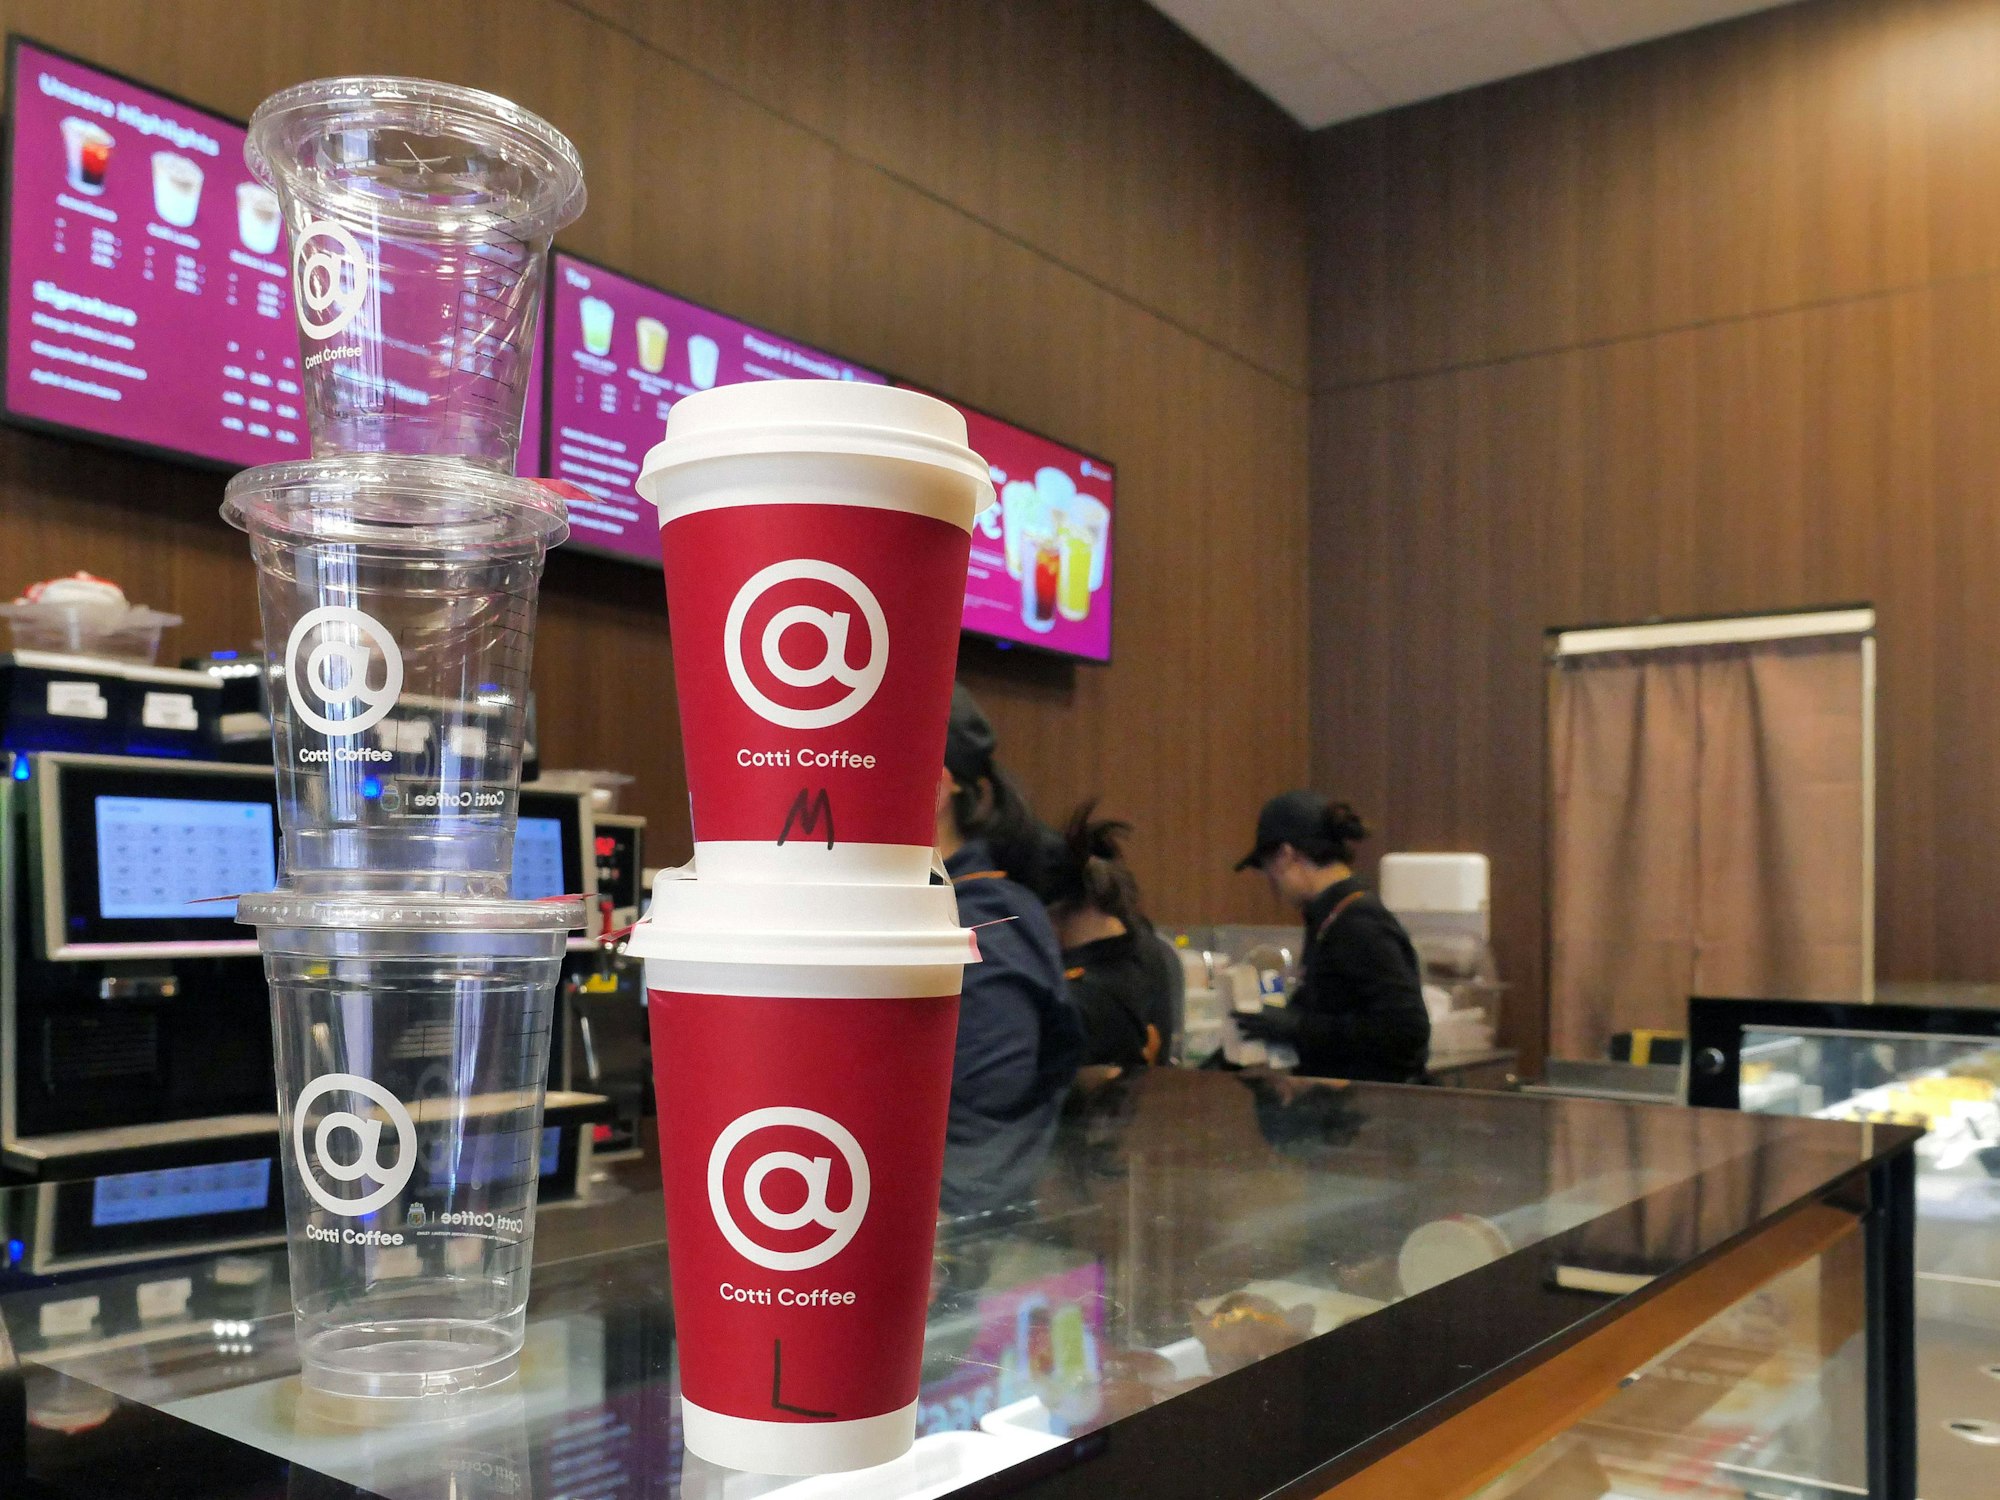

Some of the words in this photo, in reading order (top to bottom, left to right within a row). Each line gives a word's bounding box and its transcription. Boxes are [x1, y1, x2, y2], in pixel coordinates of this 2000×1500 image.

[305, 353, 323, 370] Cotti
[323, 346, 363, 360] Coffee
[335, 747, 393, 762] Coffee
[737, 748, 790, 767] Cotti
[797, 748, 876, 769] Coffee
[777, 788, 834, 850] M
[306, 1224, 339, 1244] Cotti
[342, 1228, 404, 1246] Coffee
[719, 1282, 771, 1305] Cotti
[777, 1287, 856, 1306] Coffee
[771, 1338, 837, 1418] L
